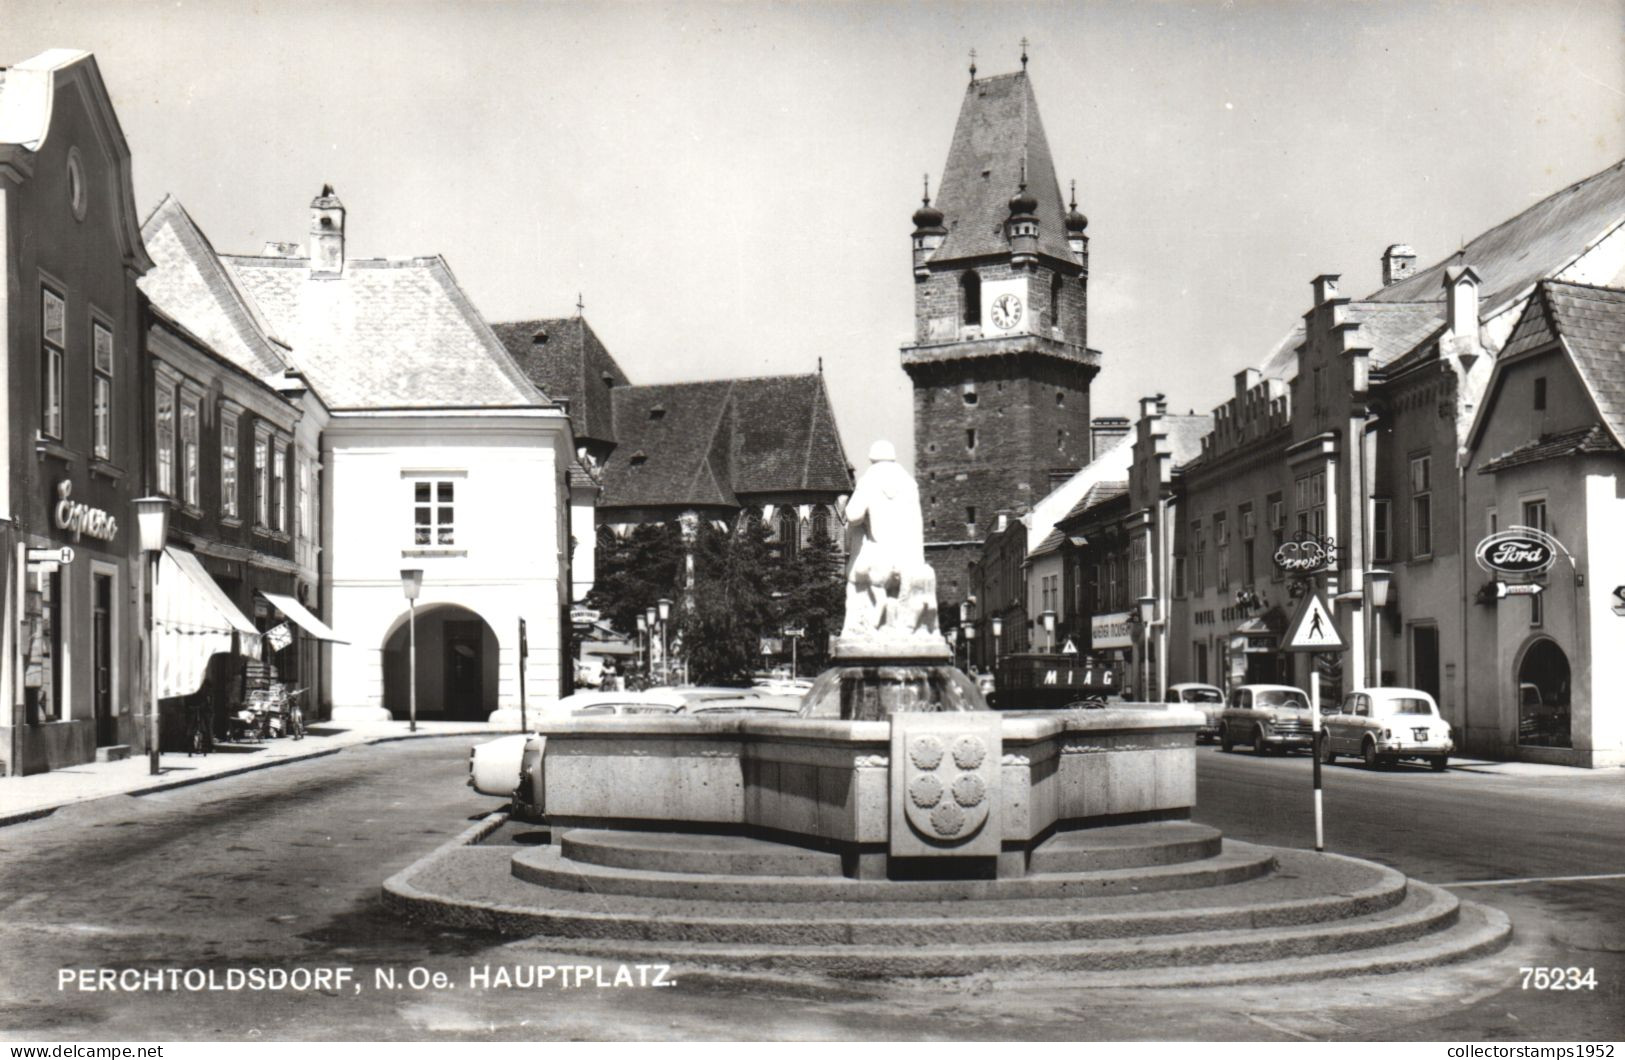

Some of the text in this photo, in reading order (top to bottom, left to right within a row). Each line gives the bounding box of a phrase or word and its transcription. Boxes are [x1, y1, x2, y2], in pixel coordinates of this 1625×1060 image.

[55, 479, 119, 543] Espresso
[61, 549, 71, 561] H
[1493, 541, 1542, 564] Ford
[1194, 608, 1216, 625] HOTEL
[1044, 670, 1113, 685] MIAG
